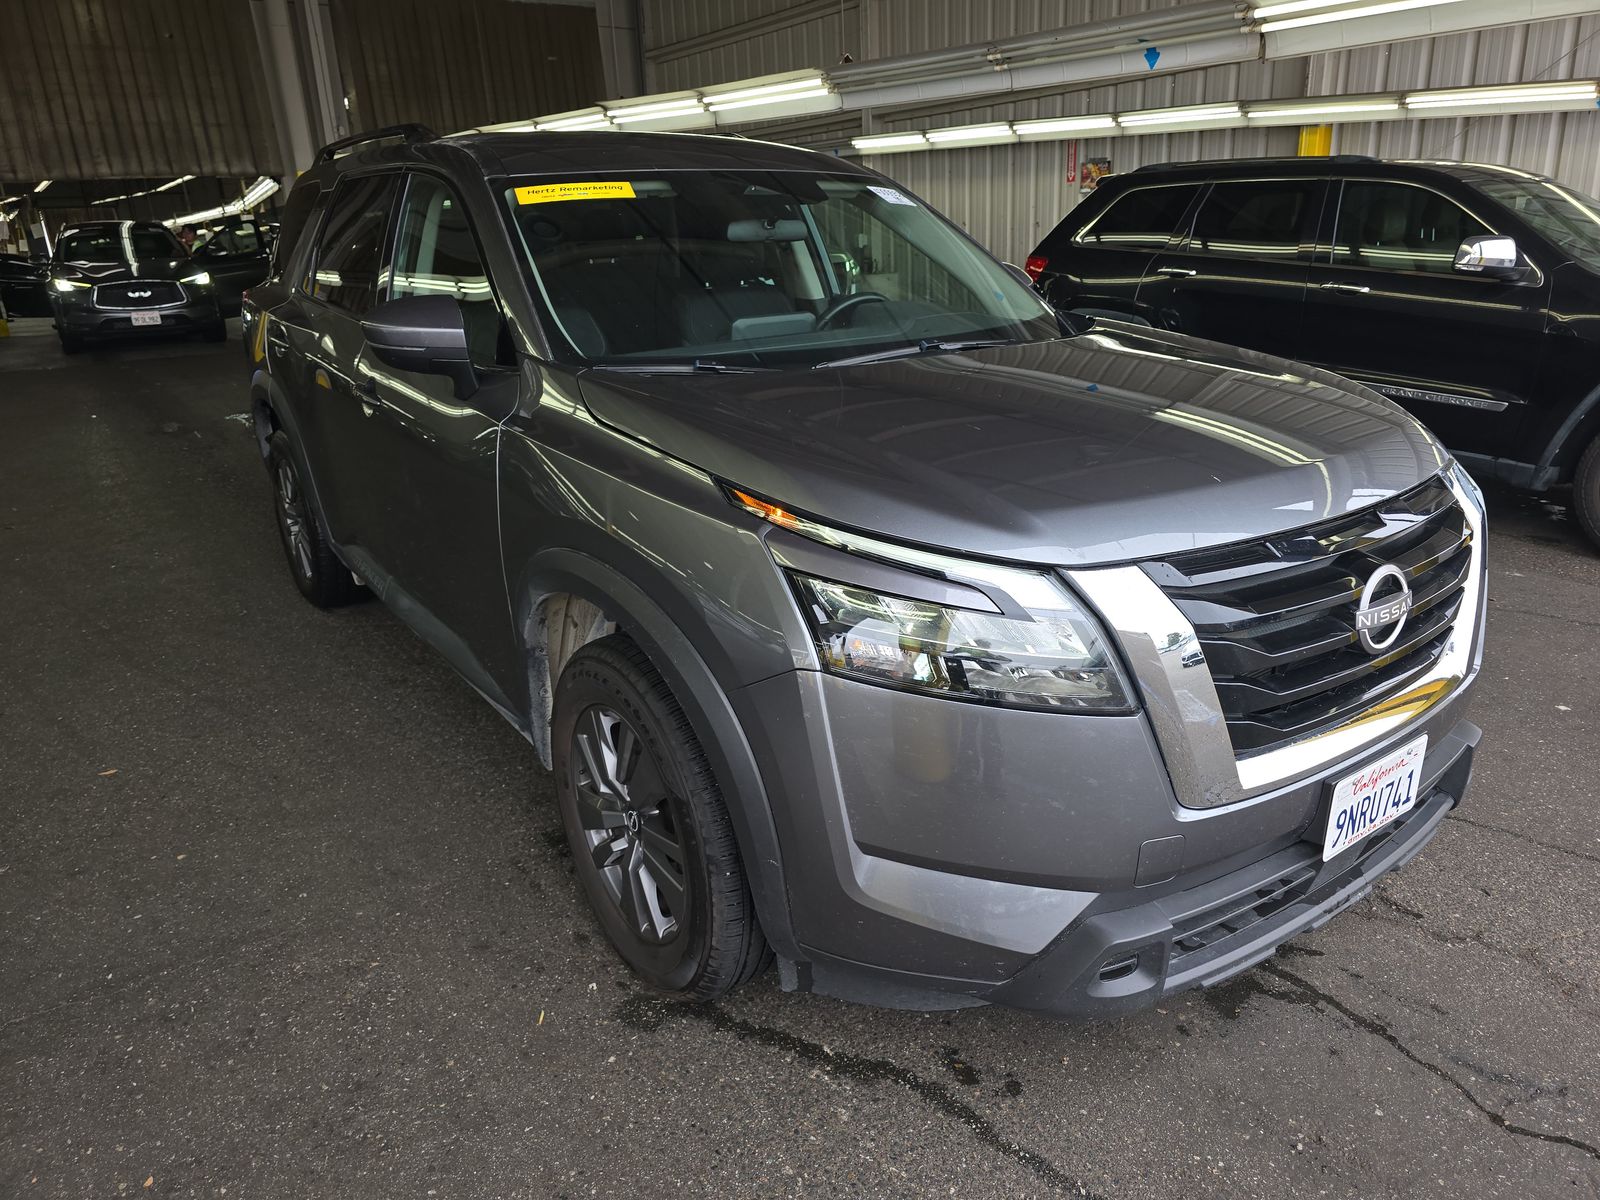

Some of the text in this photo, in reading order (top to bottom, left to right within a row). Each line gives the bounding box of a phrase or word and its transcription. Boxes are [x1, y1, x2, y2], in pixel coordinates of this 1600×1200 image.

[527, 187, 556, 195] Hertz
[559, 184, 623, 192] Remarketing
[1381, 387, 1489, 408] GRAND CHEROKEE
[1358, 598, 1412, 627] NISSAN
[1352, 757, 1408, 796] California
[1332, 769, 1414, 849] 9NRU741
[1347, 812, 1395, 846] dmv.ca.gov
